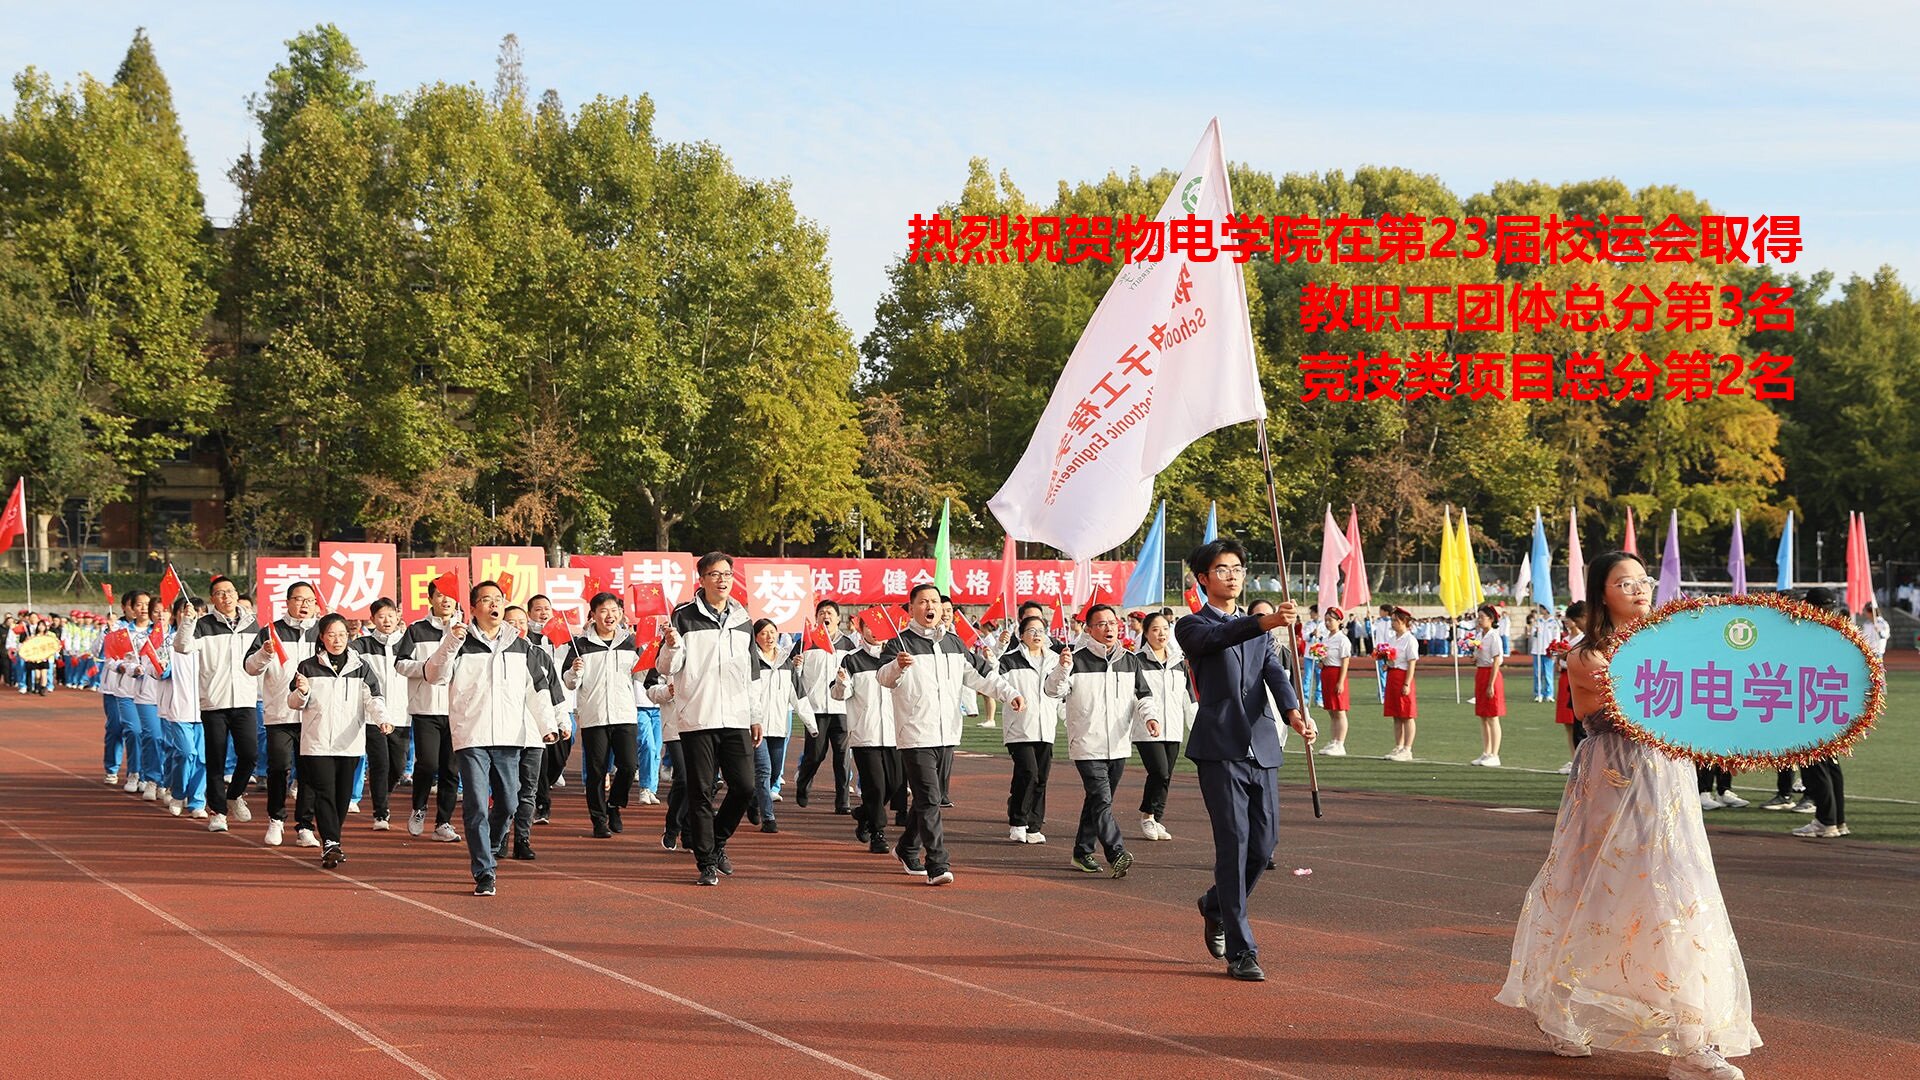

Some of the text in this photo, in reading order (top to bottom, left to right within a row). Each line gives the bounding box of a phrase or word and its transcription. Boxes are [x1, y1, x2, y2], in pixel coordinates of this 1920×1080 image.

[327, 550, 385, 612] 汲
[753, 570, 807, 625] 梦
[1634, 659, 1850, 725] 物电学院
